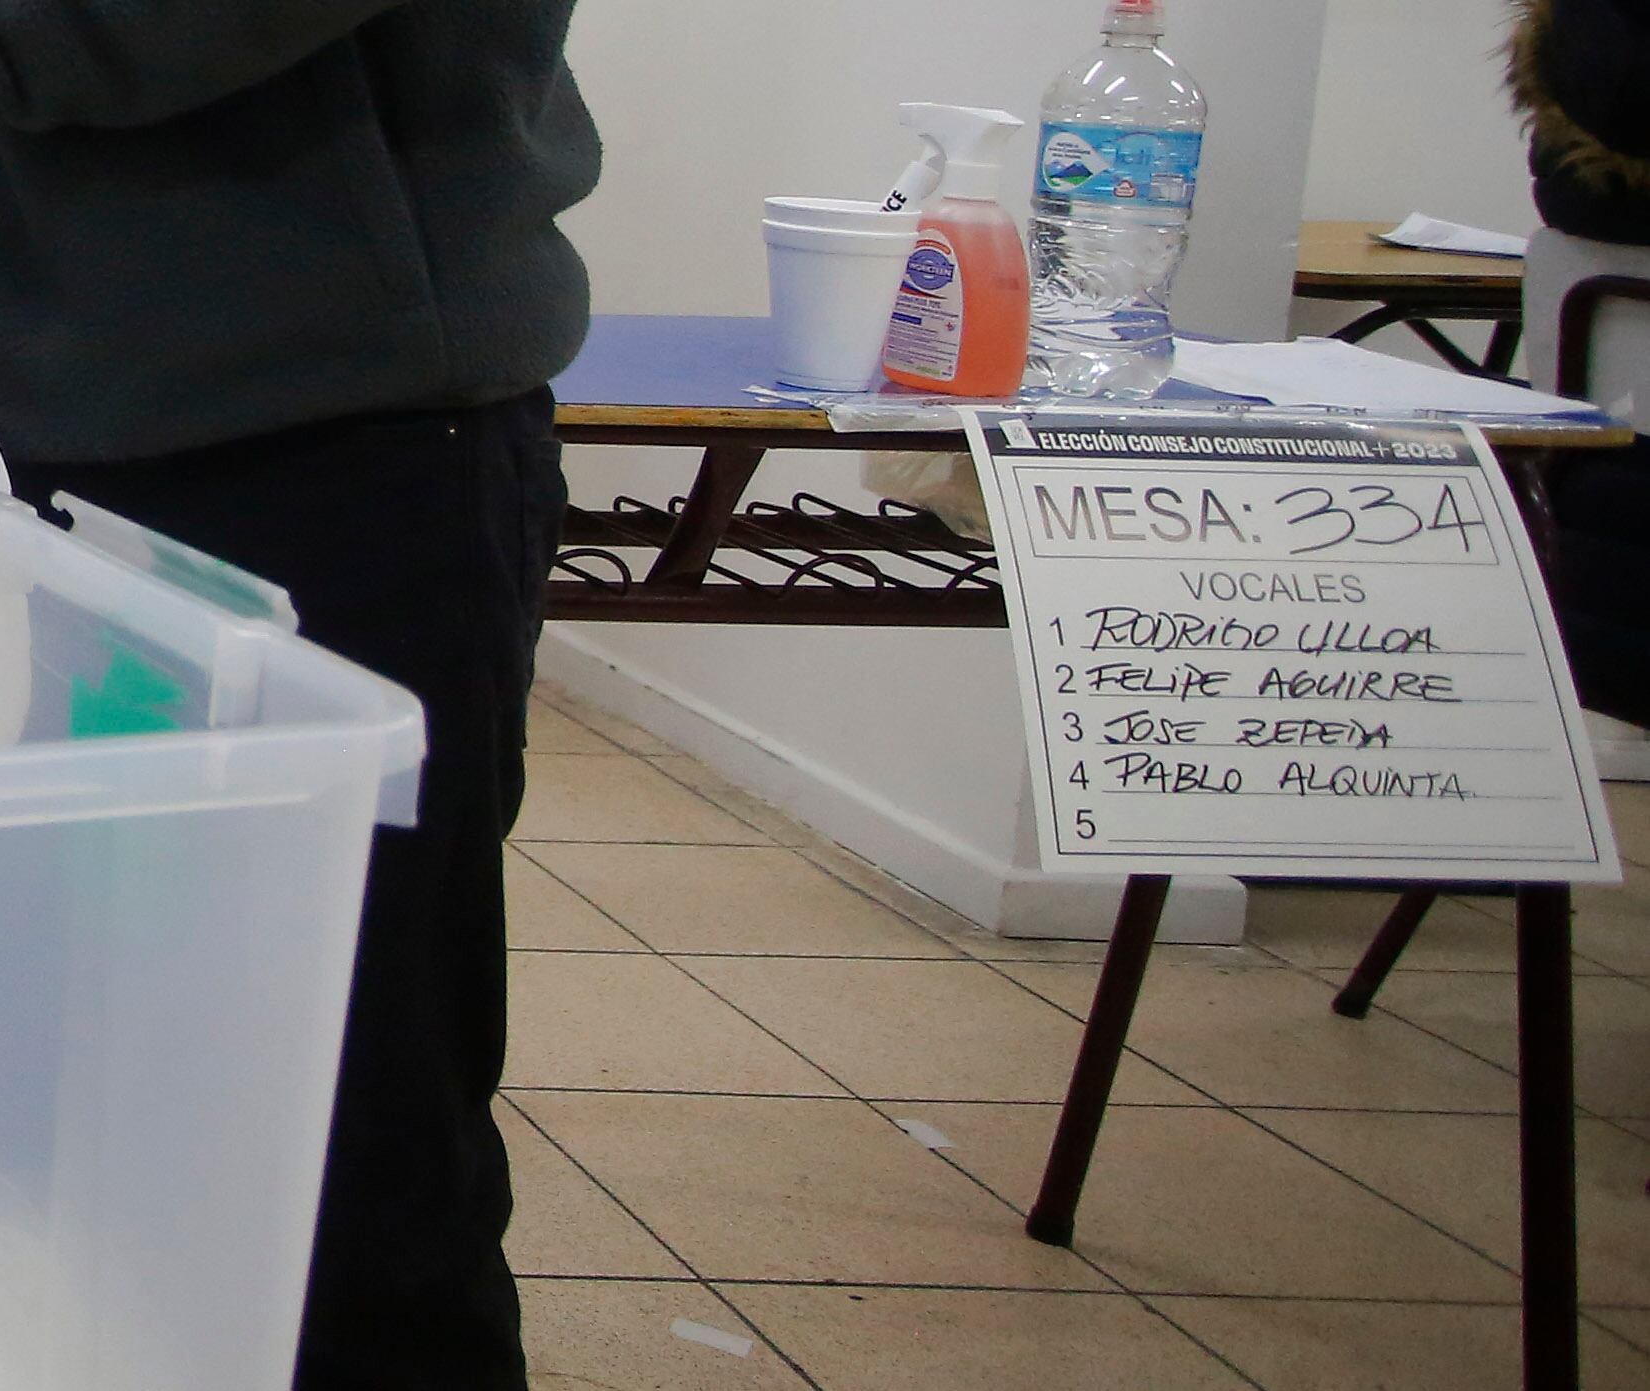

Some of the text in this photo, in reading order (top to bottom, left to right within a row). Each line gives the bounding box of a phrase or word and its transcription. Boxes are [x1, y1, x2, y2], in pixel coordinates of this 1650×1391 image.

[1038, 428, 1126, 452] ELECCIÓN
[1126, 434, 1212, 455] CONSEJO
[1213, 437, 1372, 457] CONSTITUCIONAL
[1391, 441, 1457, 460] 2023
[1033, 483, 1484, 554] MESA: 334
[1180, 571, 1366, 603] VOCALES
[1050, 606, 1441, 656] 1 RODRIGO ULLOA
[1055, 662, 1462, 702] 2 FELIPE AGUIRRE
[1063, 709, 1394, 749] 3 JOSE ZEPEDA
[1069, 761, 1089, 790] 4
[1103, 751, 1243, 794] PABLO
[1076, 809, 1096, 839] 5
